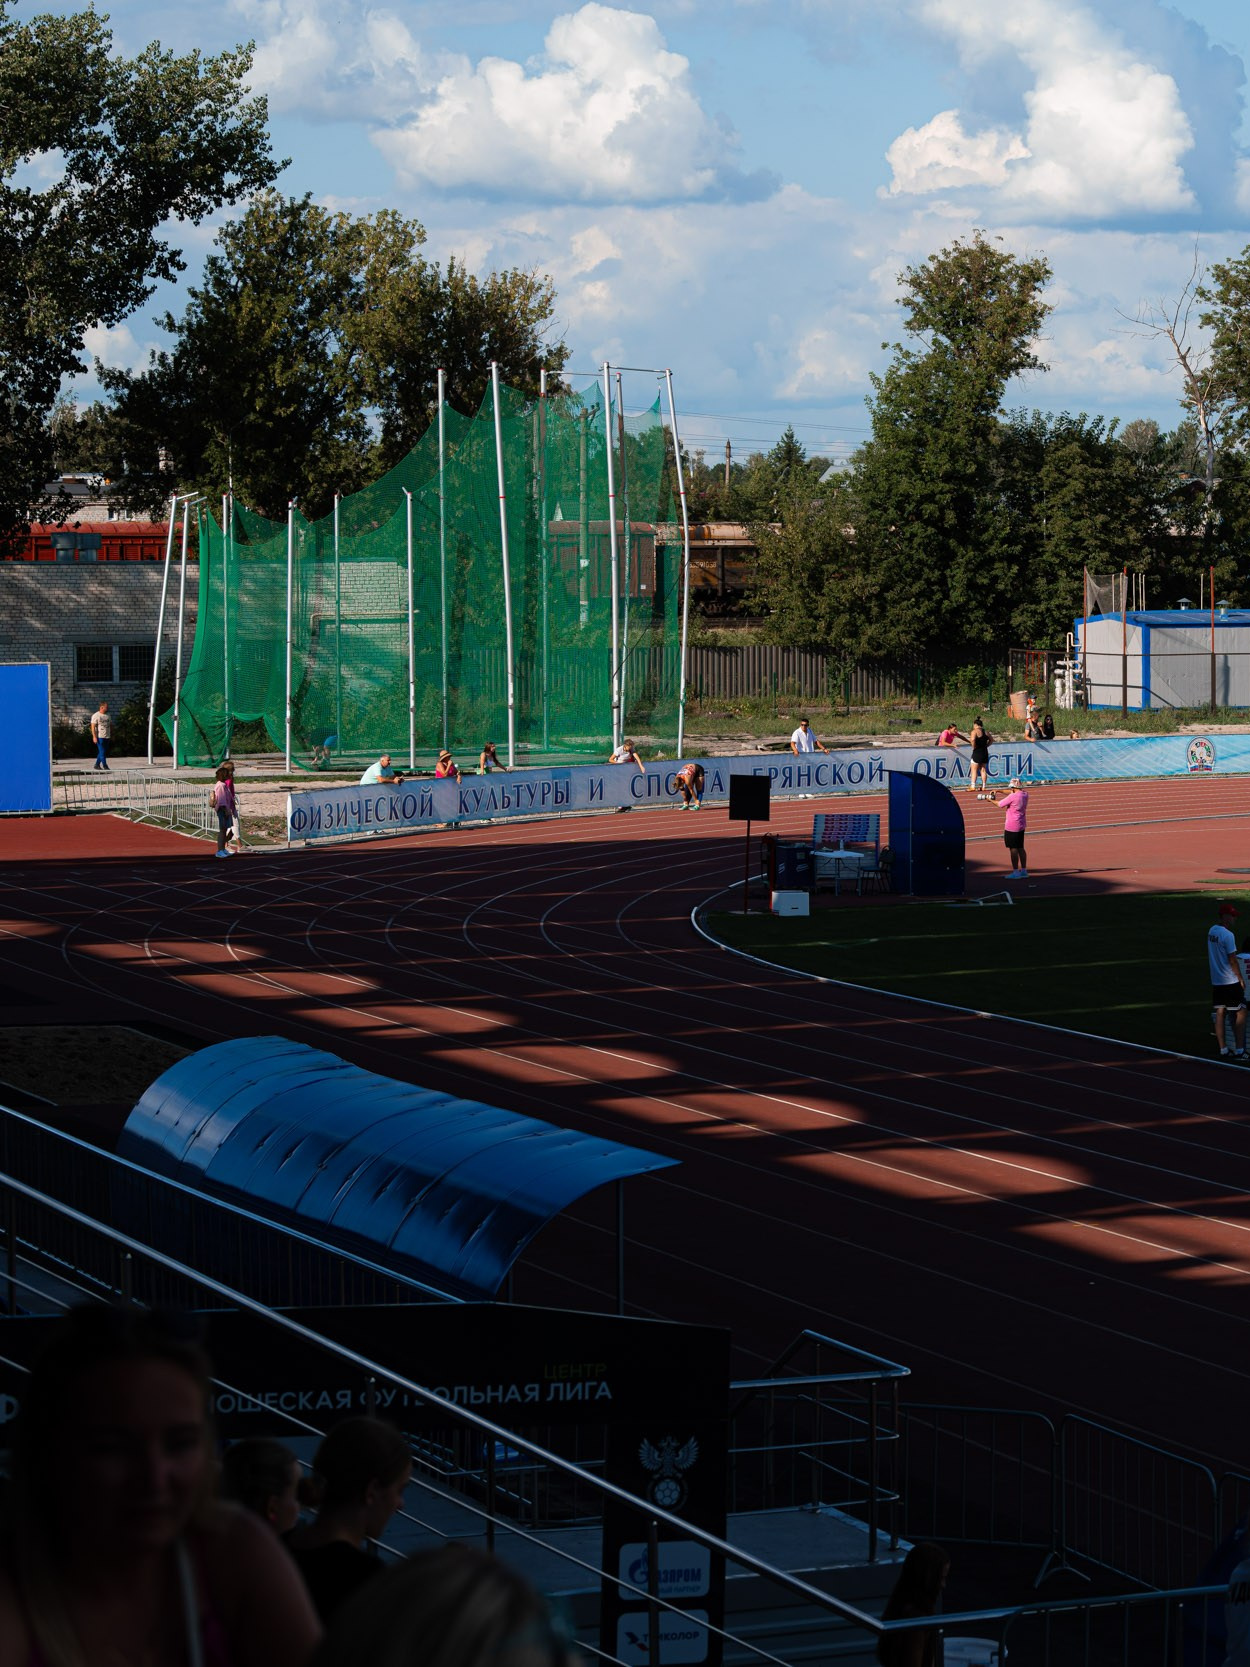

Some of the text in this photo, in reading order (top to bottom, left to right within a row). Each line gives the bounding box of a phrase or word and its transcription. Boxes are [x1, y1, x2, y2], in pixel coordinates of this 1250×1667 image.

[290, 788, 433, 832] ФИЗИЧЕСКОЙ
[458, 782, 570, 816] КУЛЬТУРЫ
[588, 778, 604, 801] И
[543, 1362, 608, 1381] ЦЕНТР
[545, 1380, 613, 1403] ЛИГА
